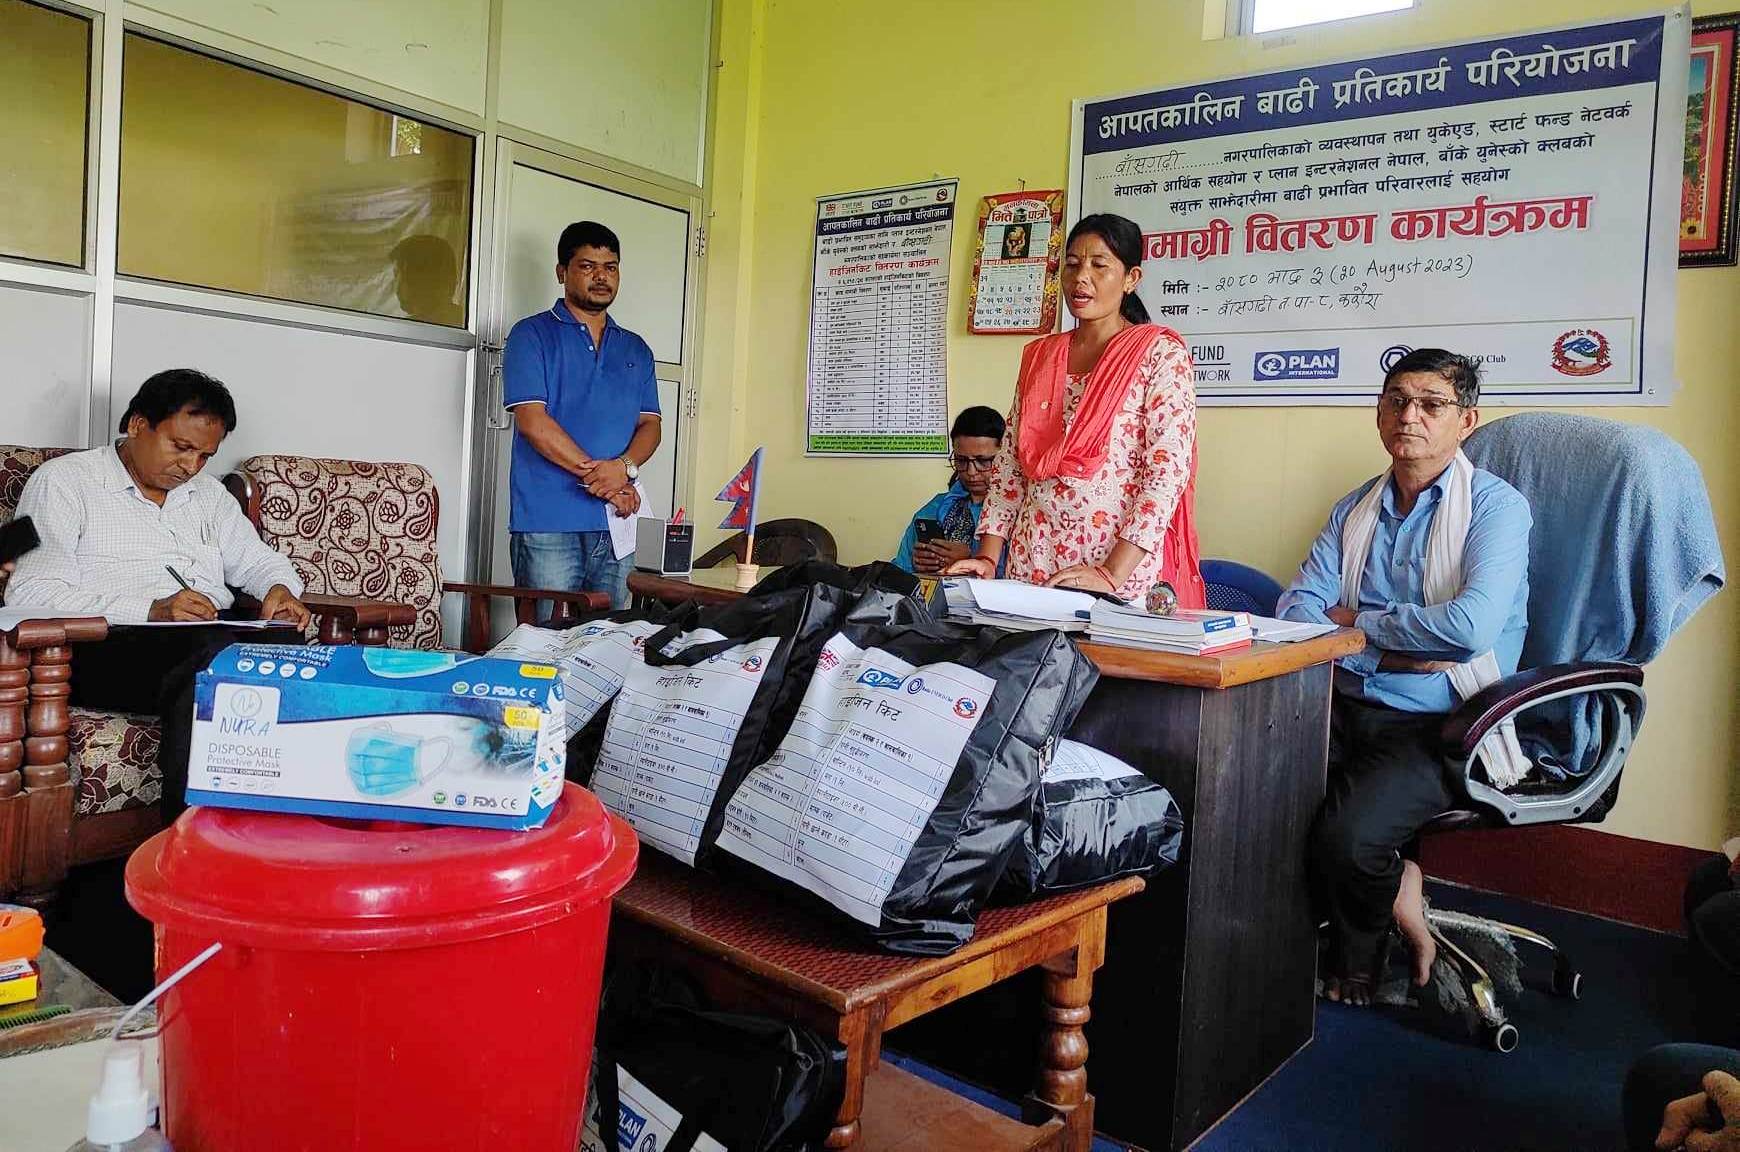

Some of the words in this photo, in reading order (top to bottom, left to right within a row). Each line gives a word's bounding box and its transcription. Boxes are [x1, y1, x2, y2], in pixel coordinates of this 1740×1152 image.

[1099, 92, 1245, 140] आपतकालिन
[1257, 77, 1319, 115] बाढी
[1333, 57, 1451, 109] प्रतिकार्य
[1466, 38, 1637, 88] परियोजना
[1223, 139, 1312, 164] नगरपालिकाको
[1319, 133, 1386, 154] व्यवस्थापन
[1393, 129, 1419, 144] तथा
[1427, 122, 1479, 140] युकेएड,
[1489, 112, 1527, 133] स्टार्ट
[1535, 111, 1574, 128] फन्ड
[1580, 101, 1632, 122] नेटवर्क
[1114, 181, 1157, 198] नेपालको
[1163, 173, 1201, 193] आर्थिक
[1208, 170, 1246, 188] सहयोग
[1253, 171, 1263, 184] र
[1268, 166, 1297, 183] प्लान
[1305, 155, 1379, 178] इन्टरनेशनल
[1387, 152, 1429, 168] नेपाल,
[1439, 144, 1470, 162] बाँके
[1477, 139, 1529, 164] युनेस्को
[1537, 132, 1596, 153] क्लबको
[1283, 184, 1311, 203] बाढी
[1319, 181, 1368, 199] प्रभावित
[1376, 170, 1453, 195] परिवारलाई
[1462, 168, 1511, 186] सहयोग
[1245, 212, 1378, 254] वितरण
[1390, 194, 1594, 242] कार्यक्रम
[1366, 256, 1422, 283] August
[1162, 279, 1191, 295] मिति
[1161, 304, 1189, 316] स्थान
[1192, 345, 1225, 361] FUND
[1289, 354, 1336, 369] PLAN
[1486, 354, 1506, 363] Club
[1193, 369, 1231, 382] TWORK
[300, 650, 334, 663] Mask
[875, 700, 903, 721] किट
[219, 716, 271, 736] NURA
[208, 742, 280, 759] DISPOSABLE
[207, 755, 252, 767] Protective
[256, 758, 280, 769] Mask
